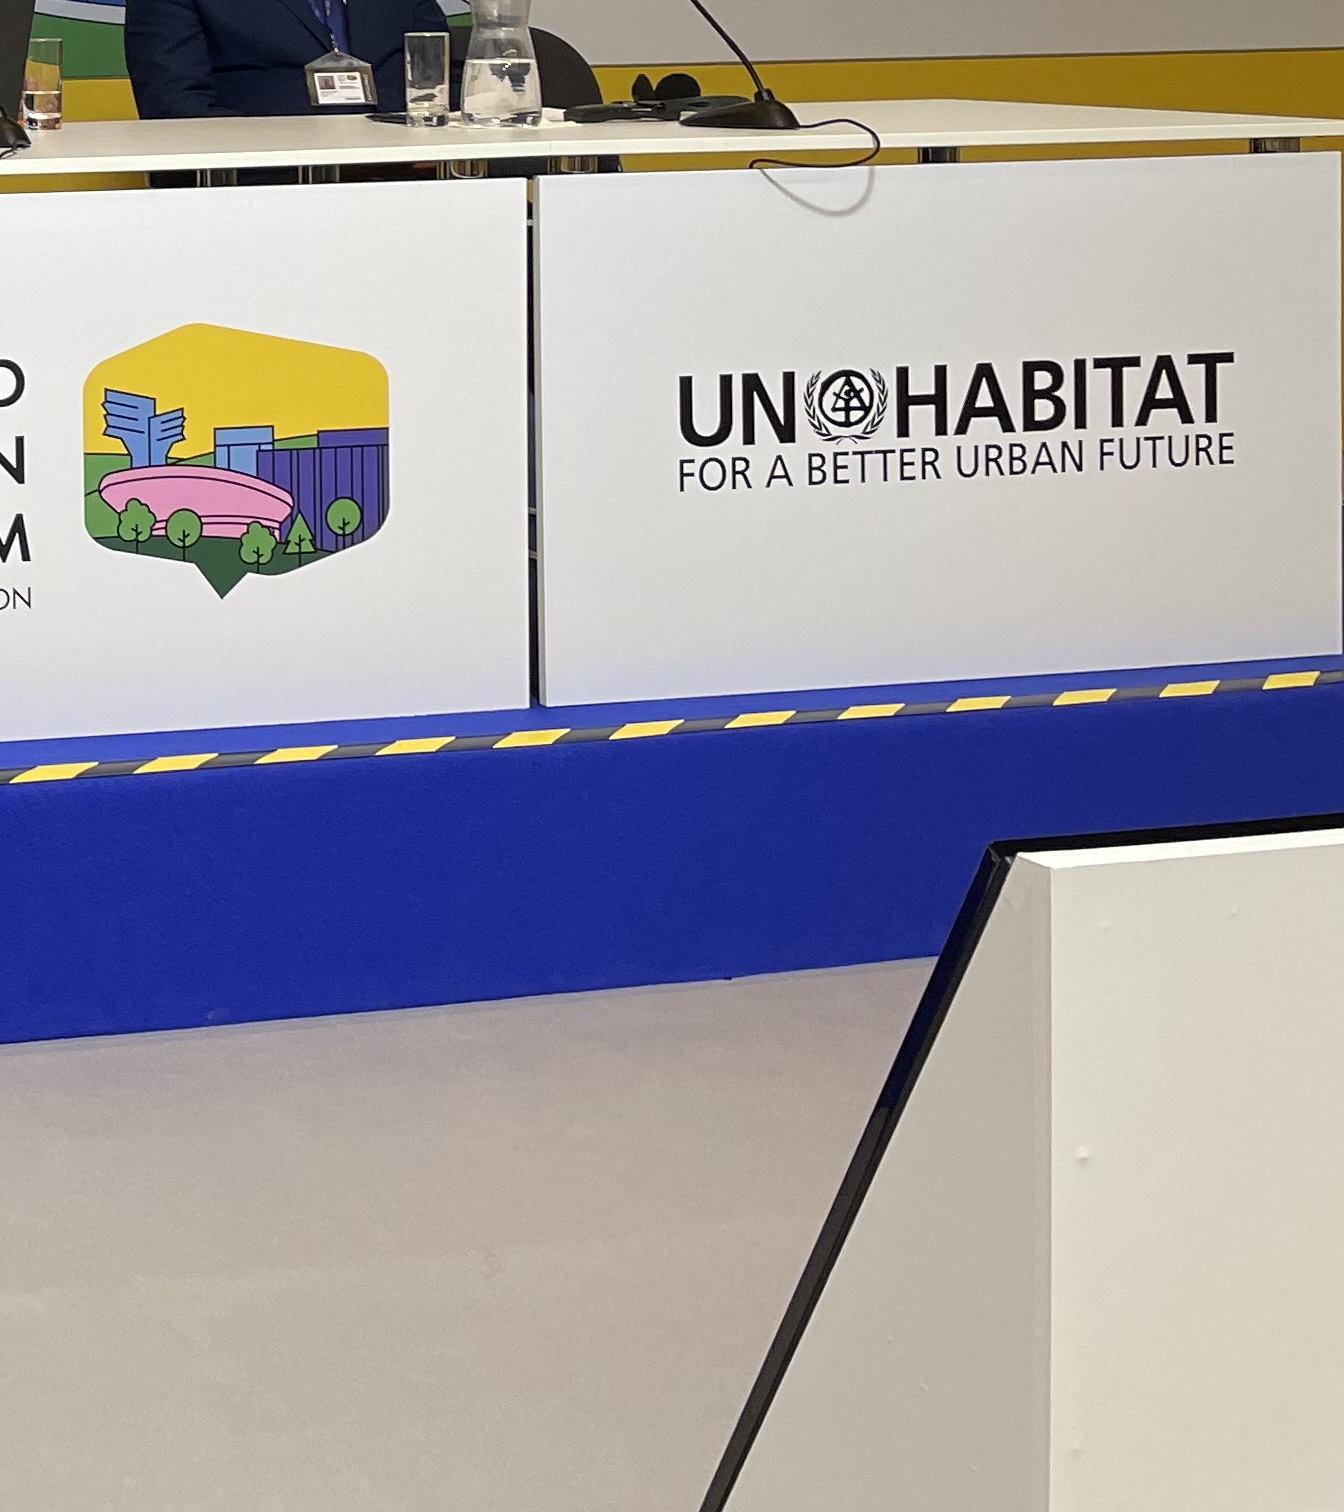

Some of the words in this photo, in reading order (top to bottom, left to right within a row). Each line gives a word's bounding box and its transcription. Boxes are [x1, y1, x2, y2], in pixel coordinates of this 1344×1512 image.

[679, 370, 796, 448] UN
[895, 351, 1235, 439] HABITAT
[679, 456, 753, 493] FOR
[765, 454, 794, 489] A
[807, 447, 942, 486] BETTER
[956, 439, 1084, 478] URBAN
[1099, 431, 1235, 471] FUTURE
